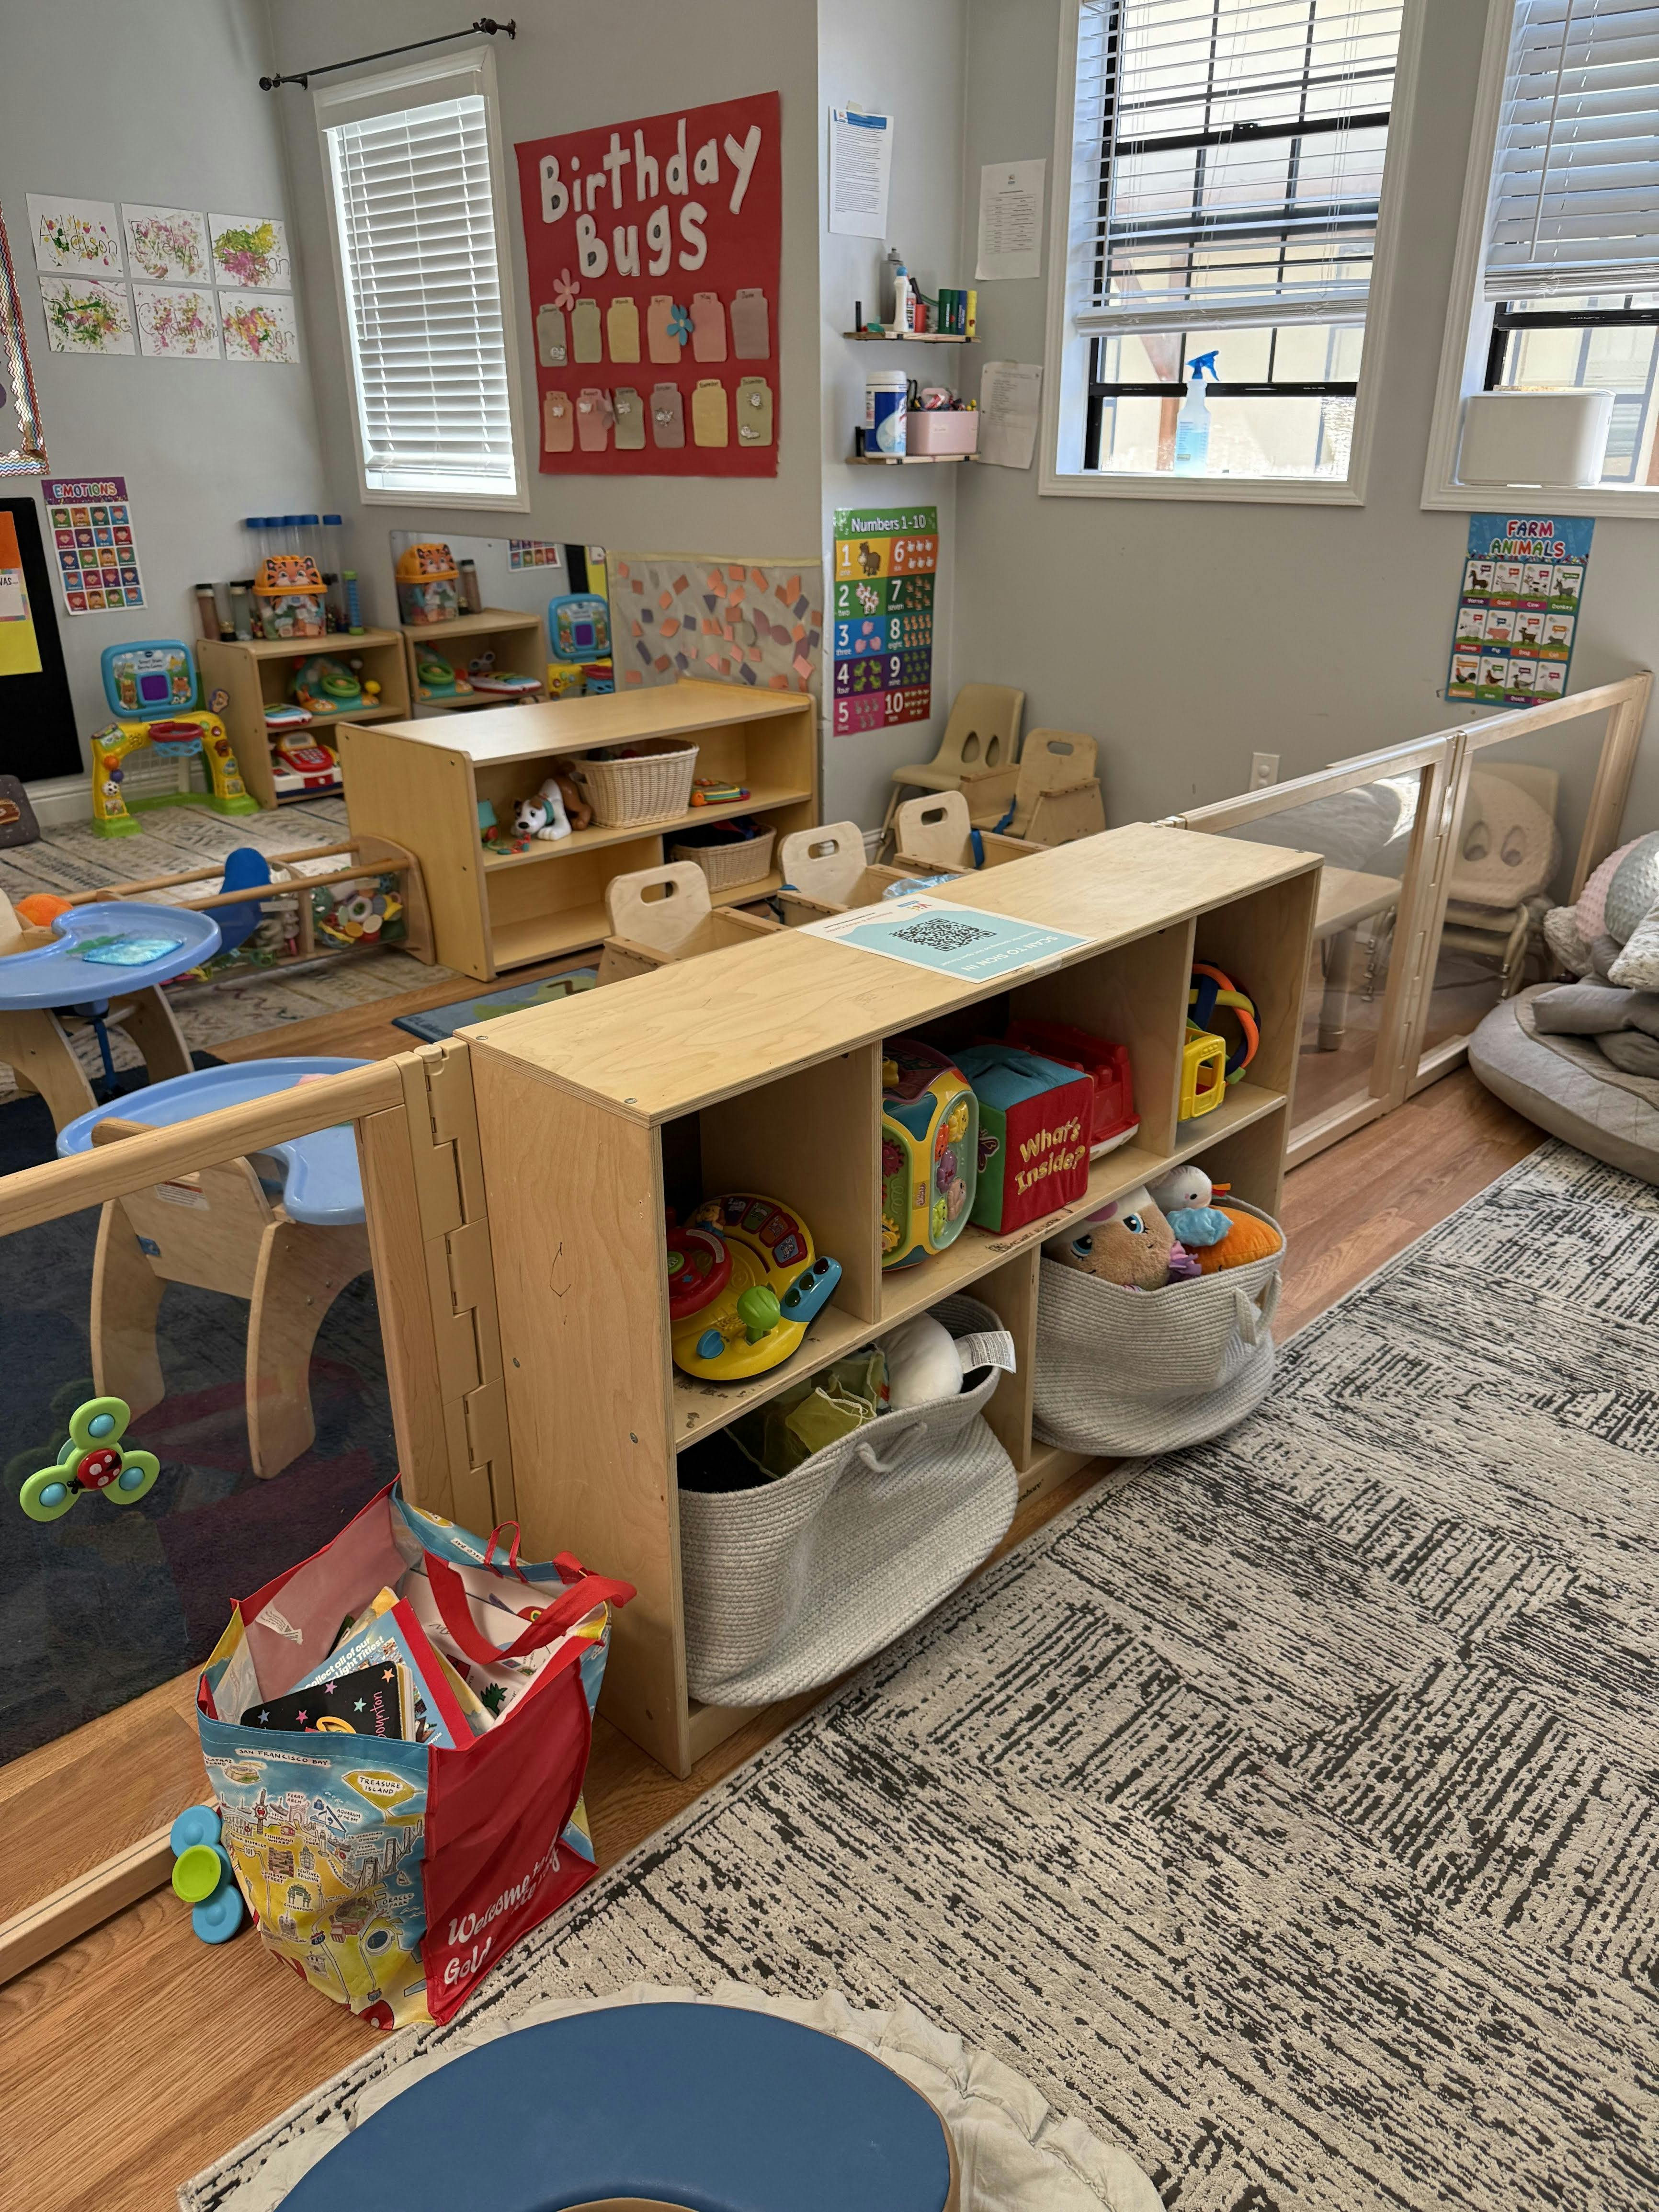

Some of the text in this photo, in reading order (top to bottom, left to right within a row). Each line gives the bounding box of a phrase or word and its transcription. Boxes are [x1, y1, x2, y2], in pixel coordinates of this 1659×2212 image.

[540, 118, 761, 223] Birthday
[40, 214, 118, 254] Addison
[131, 220, 199, 269] Evelyn
[576, 202, 708, 278] Bugs
[53, 482, 117, 499] EMOTIONS
[851, 514, 927, 533] Numbers 1-10
[1507, 520, 1554, 538] FARM
[841, 544, 851, 567] 1
[894, 540, 905, 562] 6
[1490, 538, 1565, 558] ANIMALS
[839, 585, 850, 607] 2
[891, 580, 902, 602] 7
[838, 625, 849, 646] 3
[890, 618, 900, 639] 8
[837, 663, 850, 684] 4
[890, 656, 901, 677] 9
[838, 702, 849, 722] 5
[885, 692, 904, 714] 10
[961, 935, 1058, 972] SCAN TO SIGN IN
[1020, 1117, 1081, 1163] What's
[1015, 1145, 1086, 1195] Inside?
[335, 1655, 346, 1669] all
[346, 1647, 355, 1660] of
[355, 1637, 371, 1652] our
[356, 1636, 385, 1661] Titles!
[258, 1751, 308, 1763] FRANCISCO
[359, 1777, 401, 1789] TREASURE
[364, 1786, 394, 1795] ISLAND
[336, 1808, 361, 1818] AQUARIUM
[245, 1839, 267, 1849] DISTRICT
[264, 1833, 294, 1843] FISHERMAN'S
[297, 1868, 320, 1878] SENTINEL
[297, 1873, 319, 1882] BUILDING
[284, 1903, 314, 1911] CHINATOWN
[383, 1893, 414, 1905] ORACLE
[448, 1875, 530, 1945] Welcome
